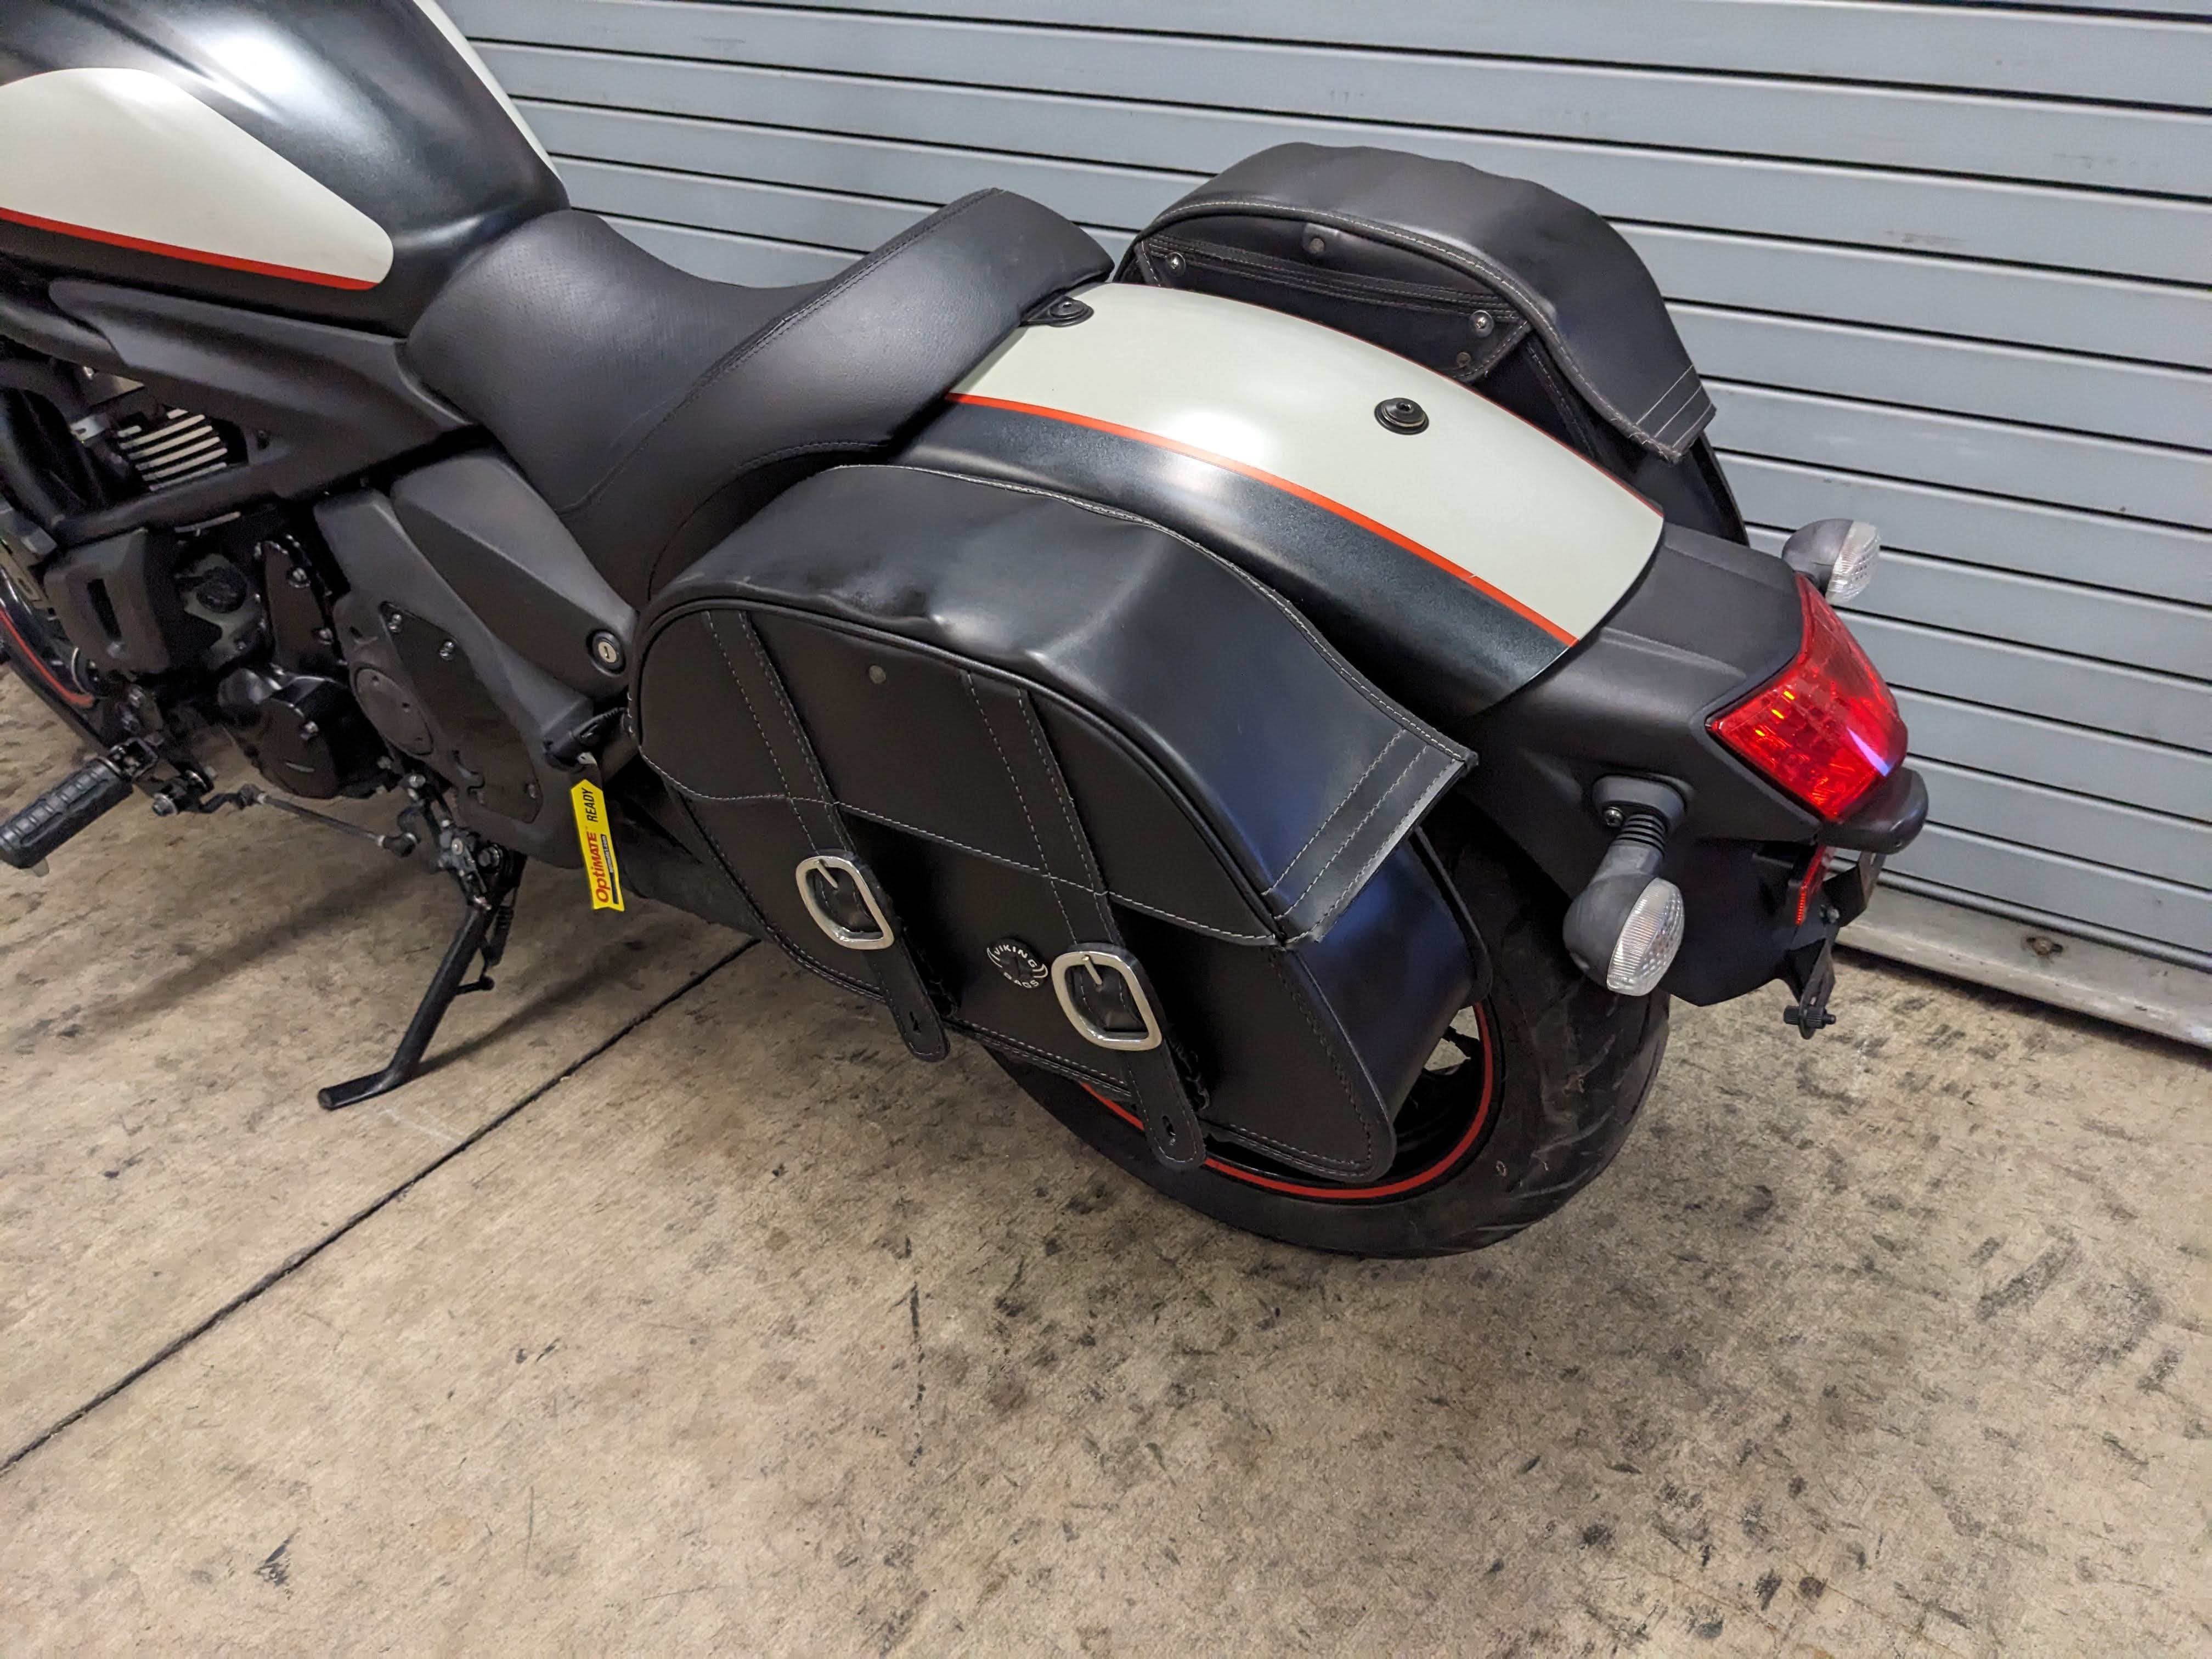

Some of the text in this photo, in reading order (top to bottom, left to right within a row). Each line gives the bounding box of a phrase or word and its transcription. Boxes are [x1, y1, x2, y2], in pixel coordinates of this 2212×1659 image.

[582, 788, 599, 822] READY
[994, 944, 1038, 968] VIKING
[1003, 972, 1040, 988] BAGS
